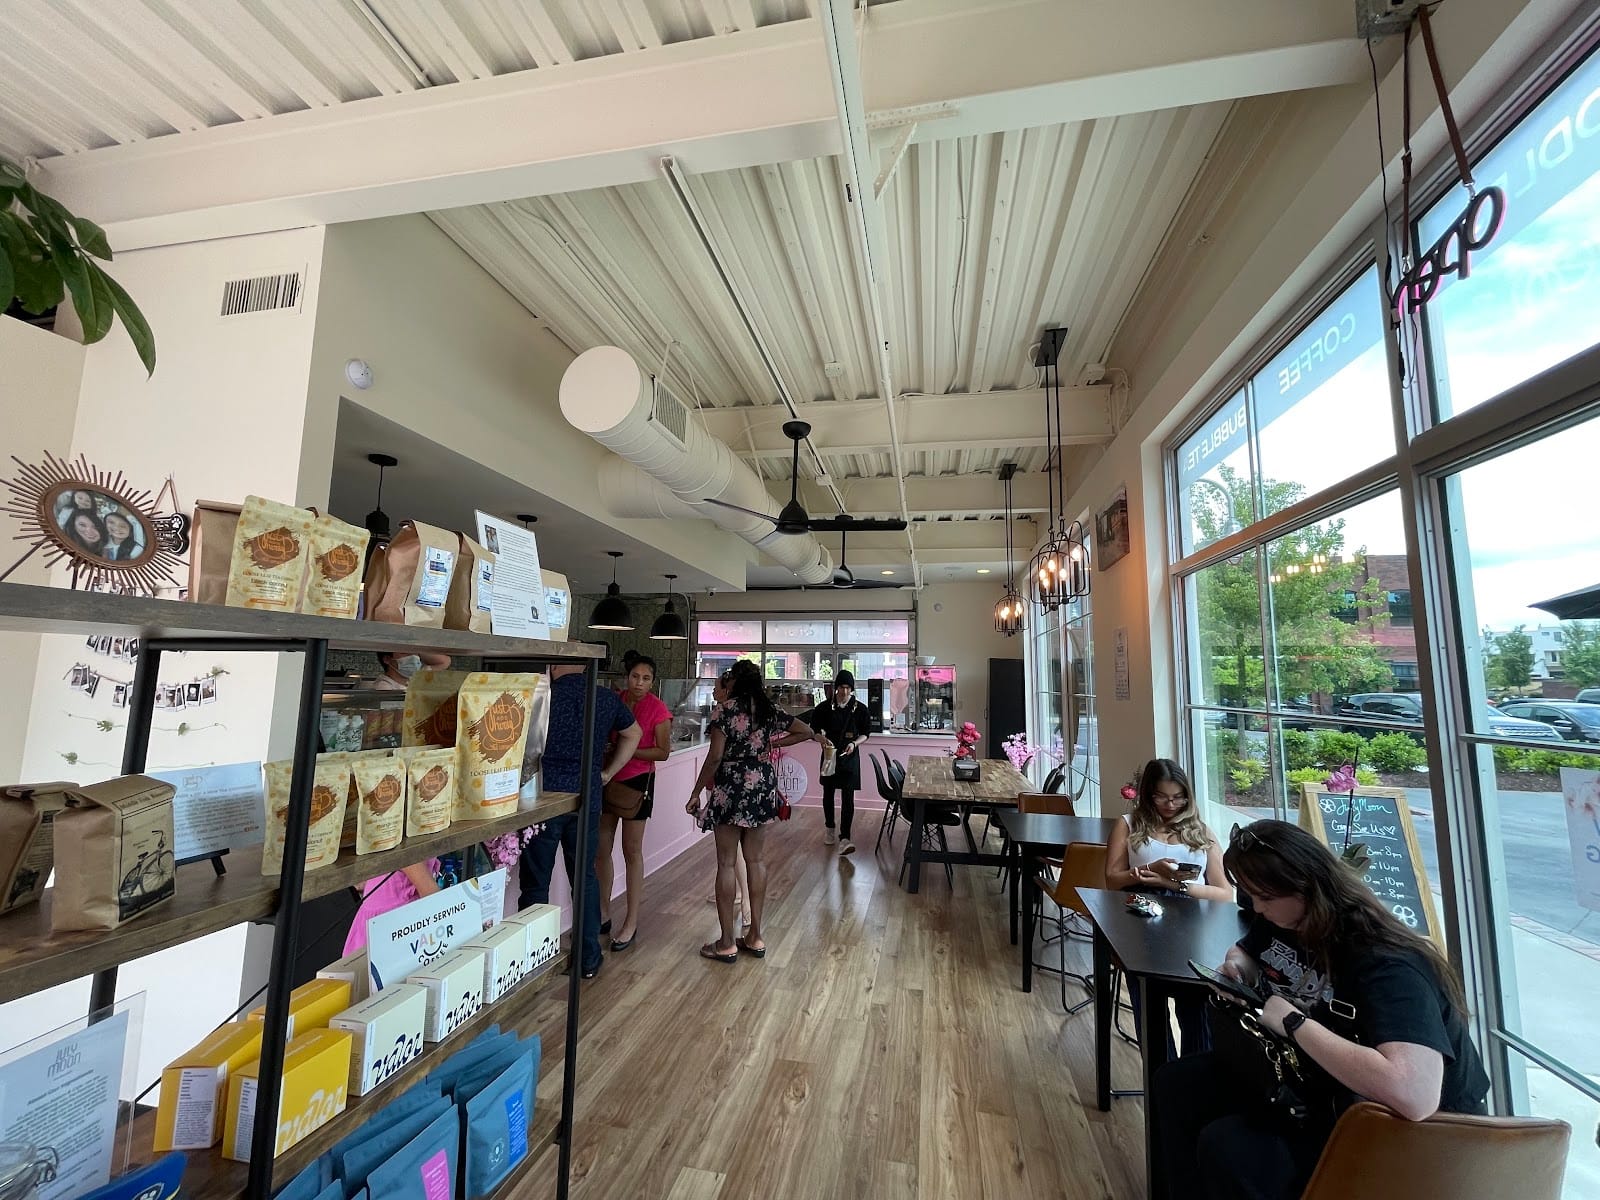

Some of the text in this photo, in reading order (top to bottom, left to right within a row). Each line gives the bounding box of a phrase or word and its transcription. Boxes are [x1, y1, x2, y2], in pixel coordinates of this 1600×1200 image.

[391, 916, 431, 942] PROUDLY
[433, 901, 466, 924] SERVING
[410, 924, 455, 955] VALOR
[371, 1031, 422, 1086] valor
